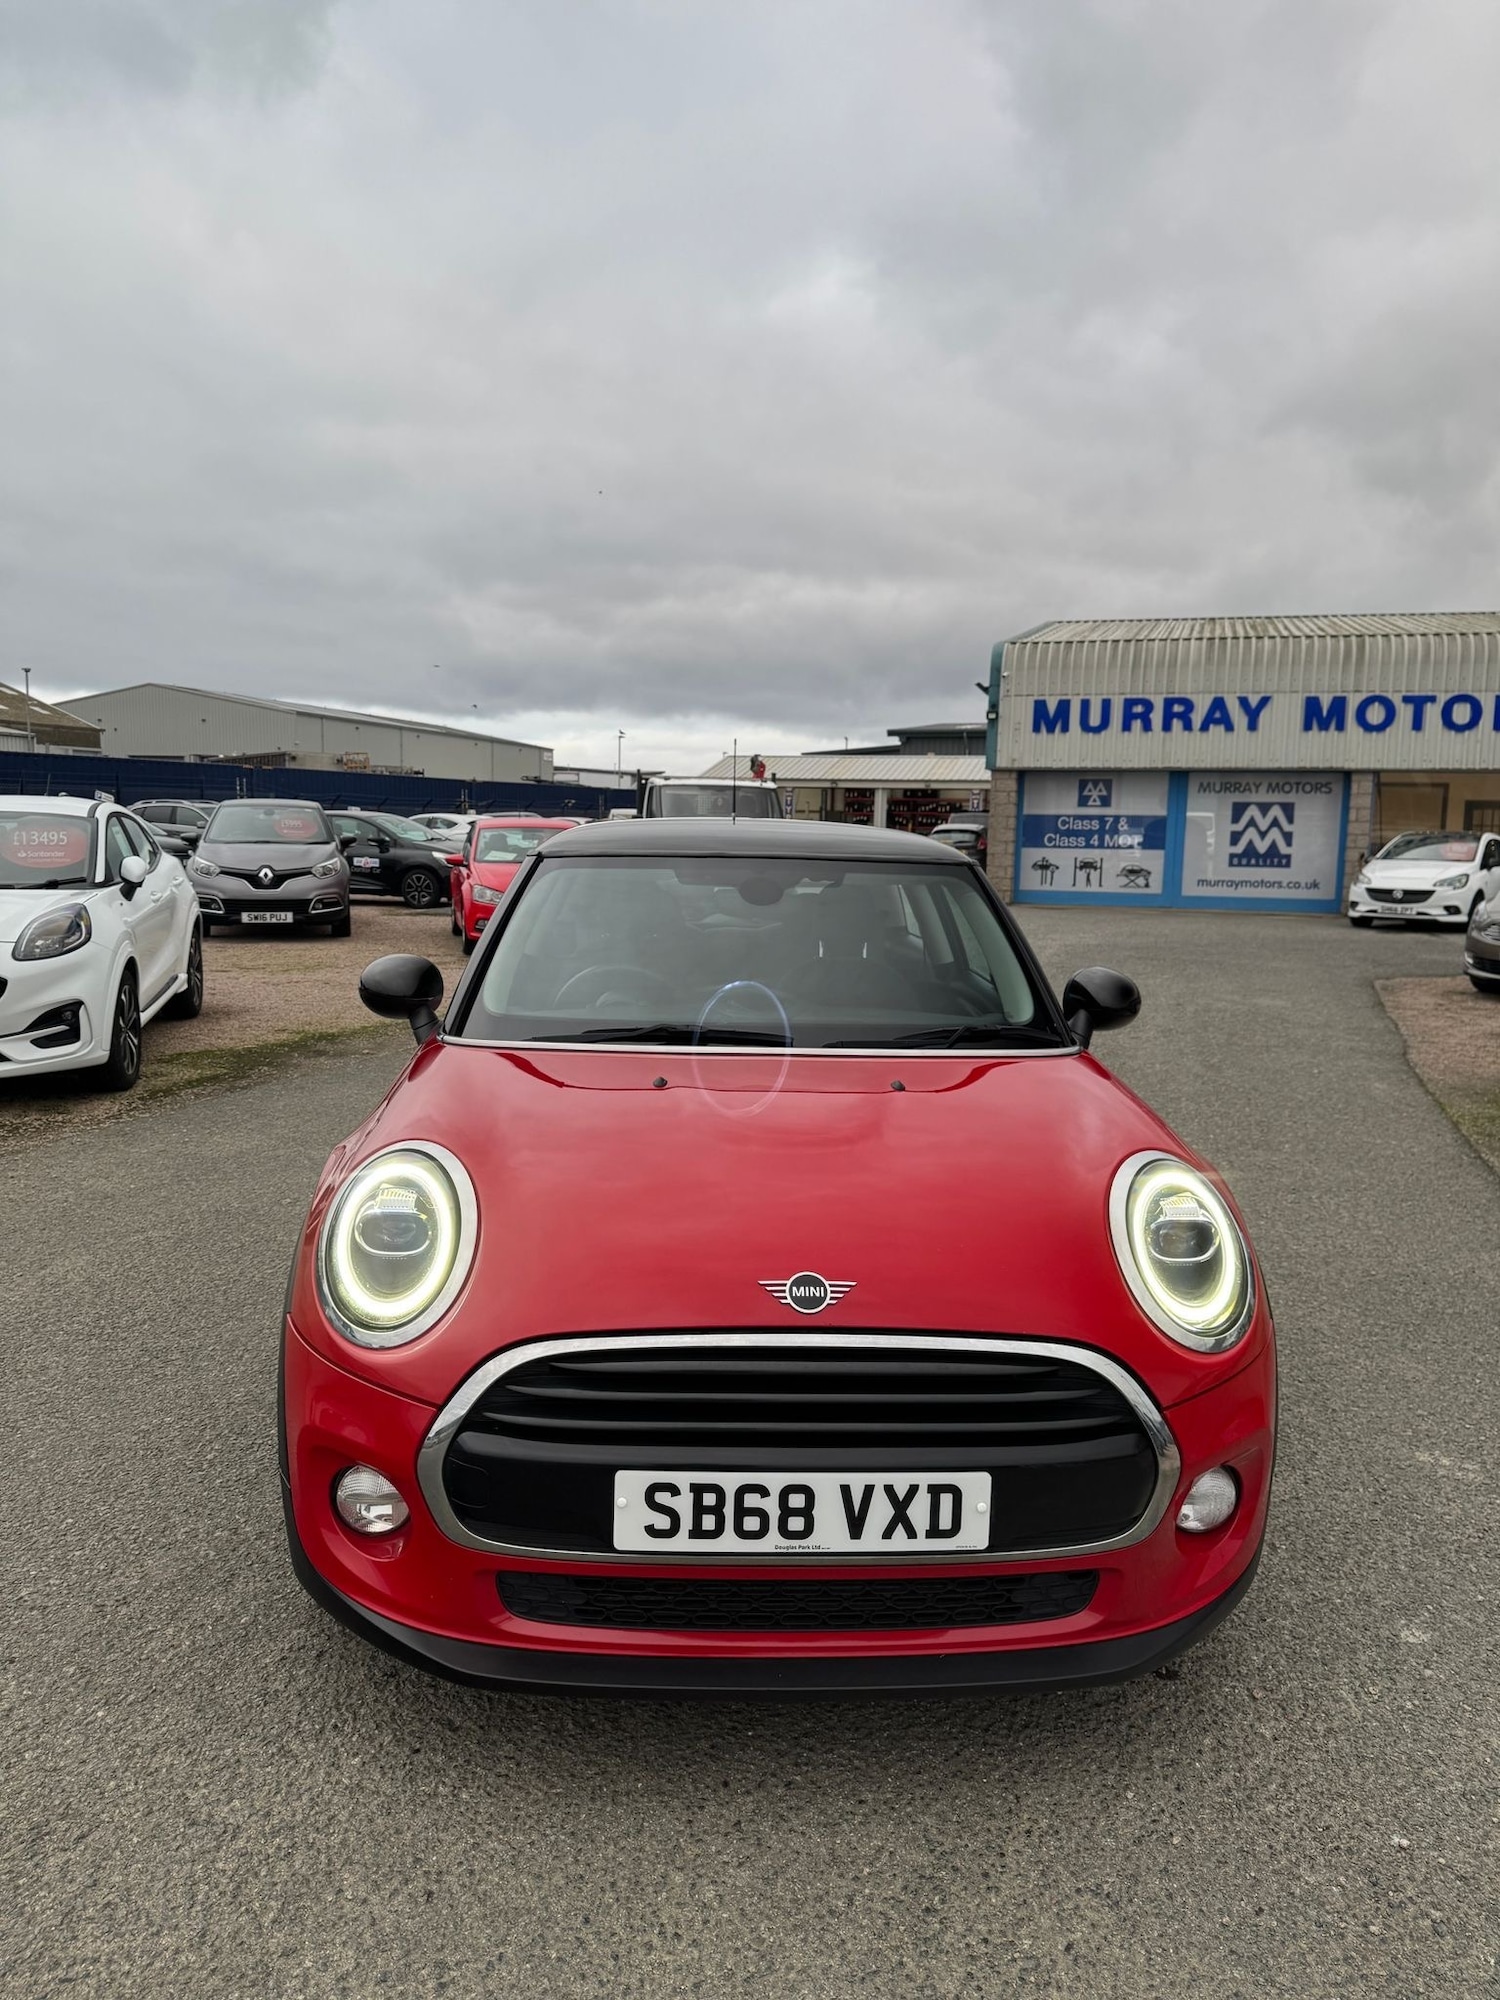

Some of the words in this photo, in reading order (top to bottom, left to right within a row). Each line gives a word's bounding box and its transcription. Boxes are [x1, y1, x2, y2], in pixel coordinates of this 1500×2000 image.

[1032, 695, 1272, 734] MURRAY
[1302, 694, 1500, 733] MOTO
[1198, 781, 1262, 794] MURRAY
[1266, 782, 1333, 795] MOTORS
[1057, 816, 1100, 830] Class
[1104, 817, 1114, 830] 7
[1118, 817, 1129, 830] &
[13, 830, 68, 846] £13495
[1044, 833, 1086, 847] Class
[1090, 834, 1099, 847] 4
[1104, 834, 1144, 848] MOT
[27, 850, 65, 858] Santander
[1232, 858, 1288, 866] QUALITY
[1197, 878, 1320, 891] murraymotors.co.uk
[247, 913, 268, 922] SW16
[270, 913, 288, 922] PUJ
[792, 1286, 825, 1297] MINI
[644, 1482, 816, 1540] SB68
[839, 1484, 963, 1540] VXD
